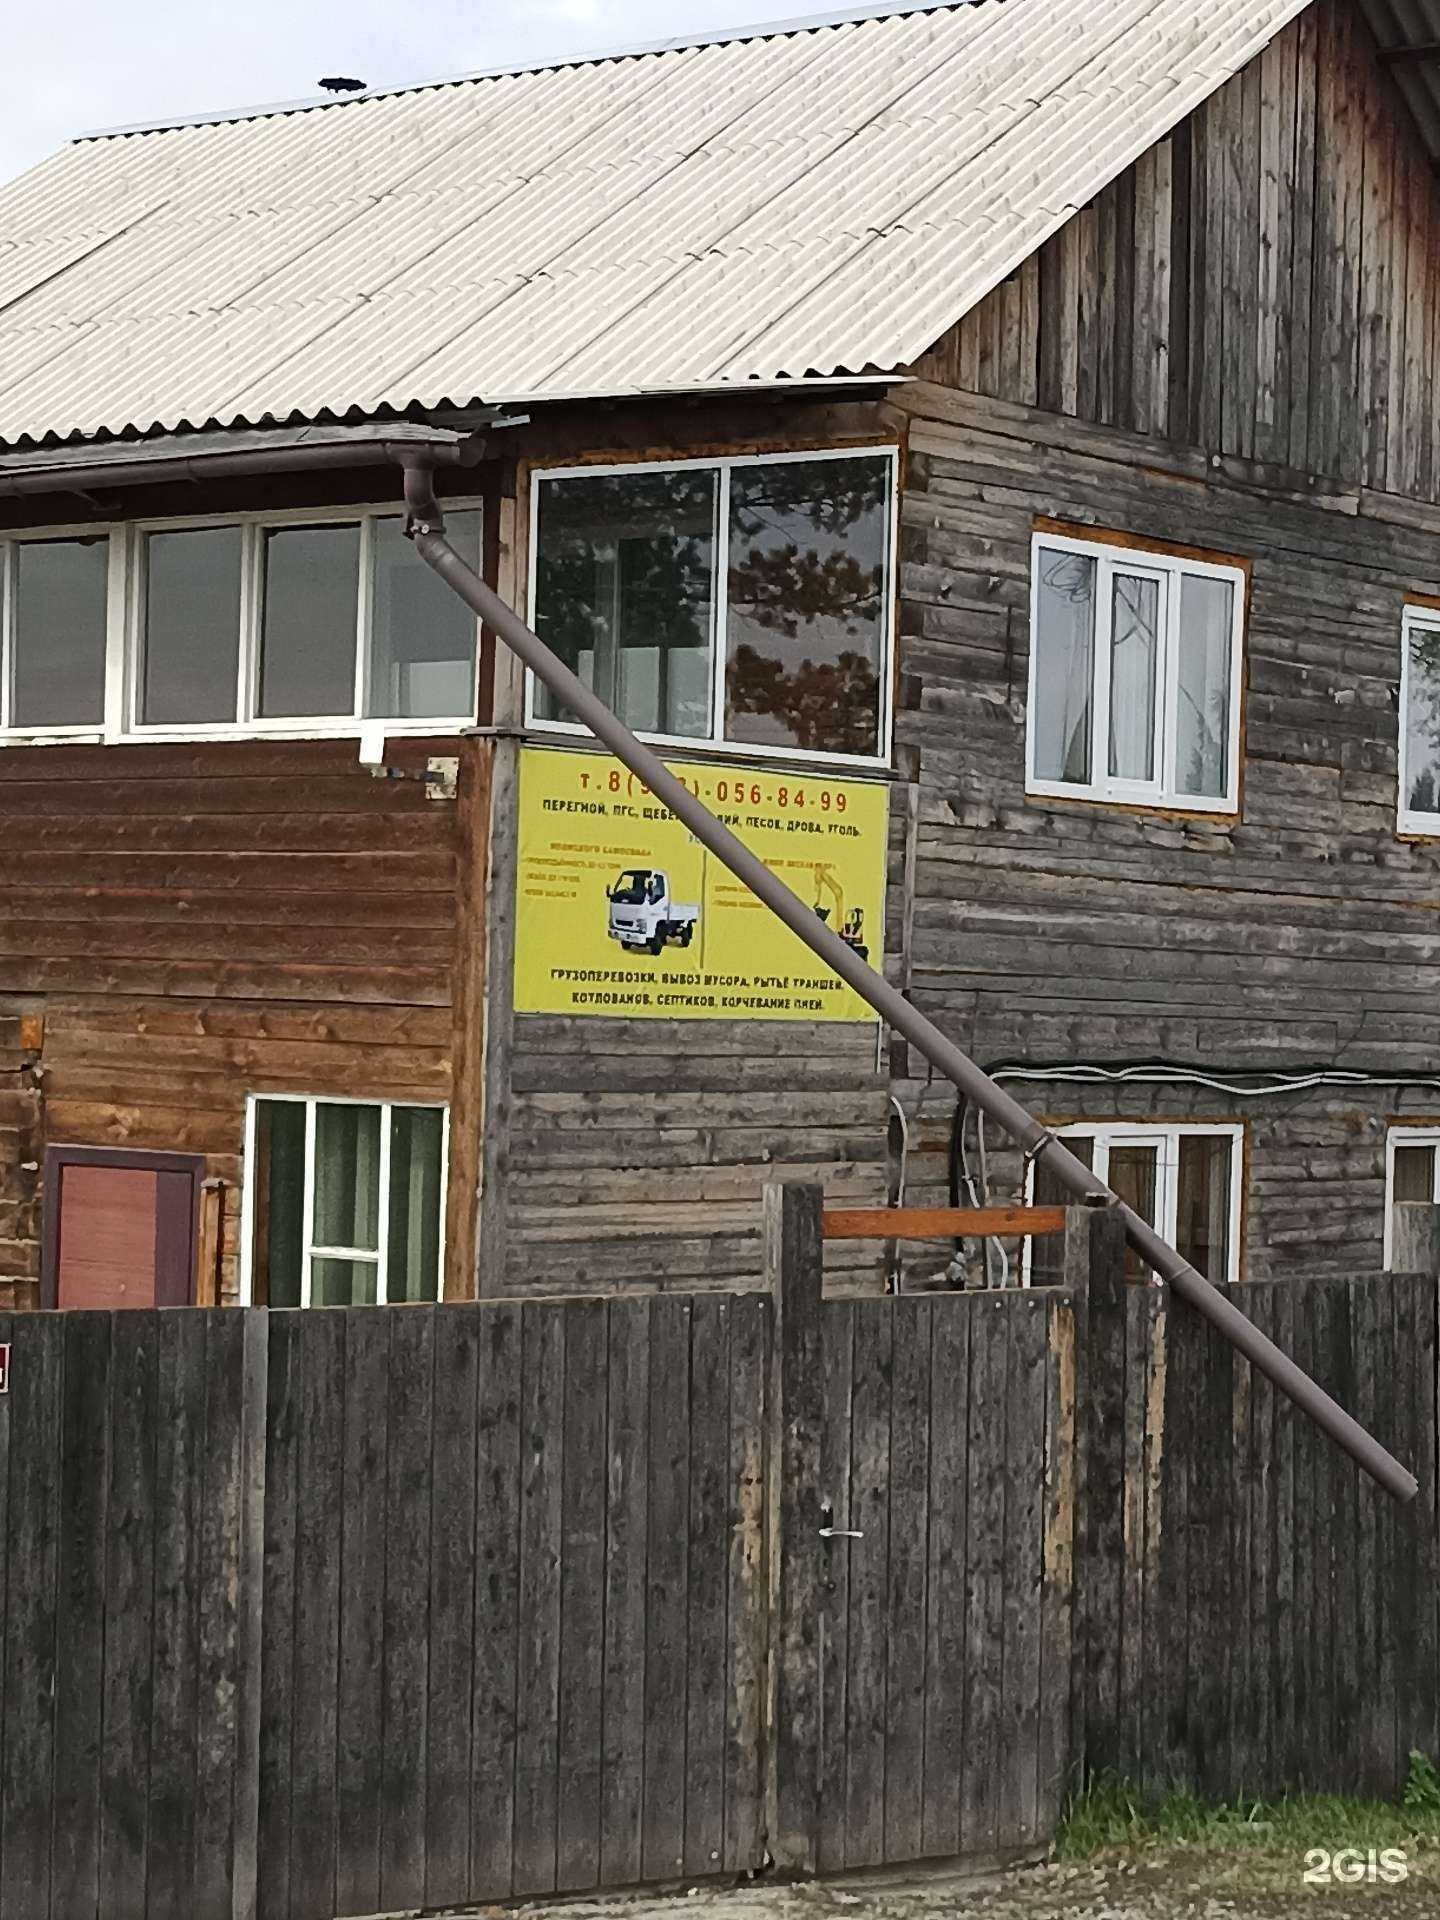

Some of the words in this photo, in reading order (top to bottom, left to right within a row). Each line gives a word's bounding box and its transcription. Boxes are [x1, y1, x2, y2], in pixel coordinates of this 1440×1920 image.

[613, 804, 639, 819] ПГС,
[551, 968, 658, 984] ГРУЗОПЕРЕВОЗКИ,
[662, 973, 701, 985] ВЫВОЗ
[721, 996, 790, 1010] КОРЧЕВАНИЕ
